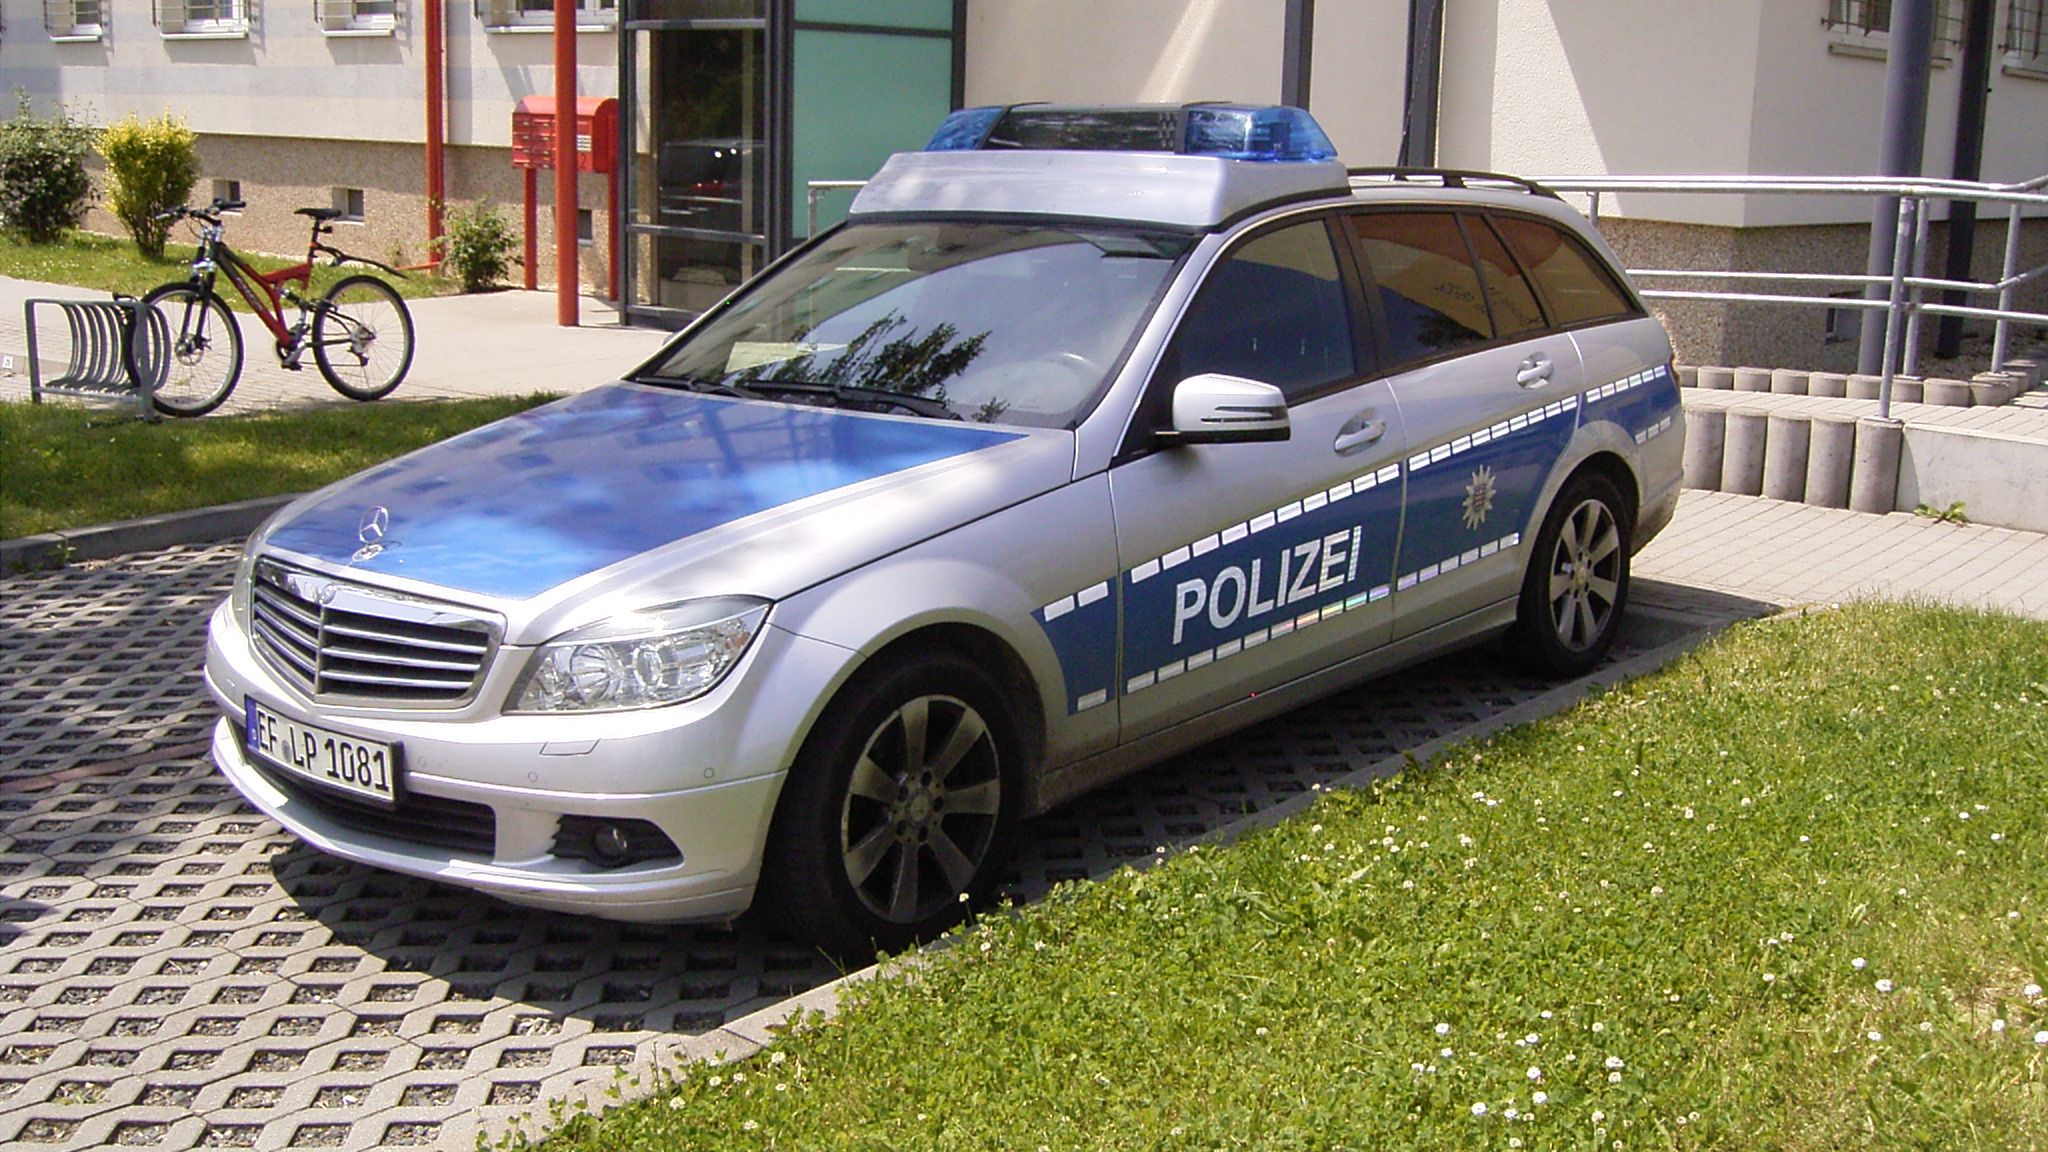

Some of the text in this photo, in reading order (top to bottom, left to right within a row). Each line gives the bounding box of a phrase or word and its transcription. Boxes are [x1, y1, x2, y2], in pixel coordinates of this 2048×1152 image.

[1172, 524, 1363, 645] POLIZEI
[257, 709, 389, 791] EF LP 1081
